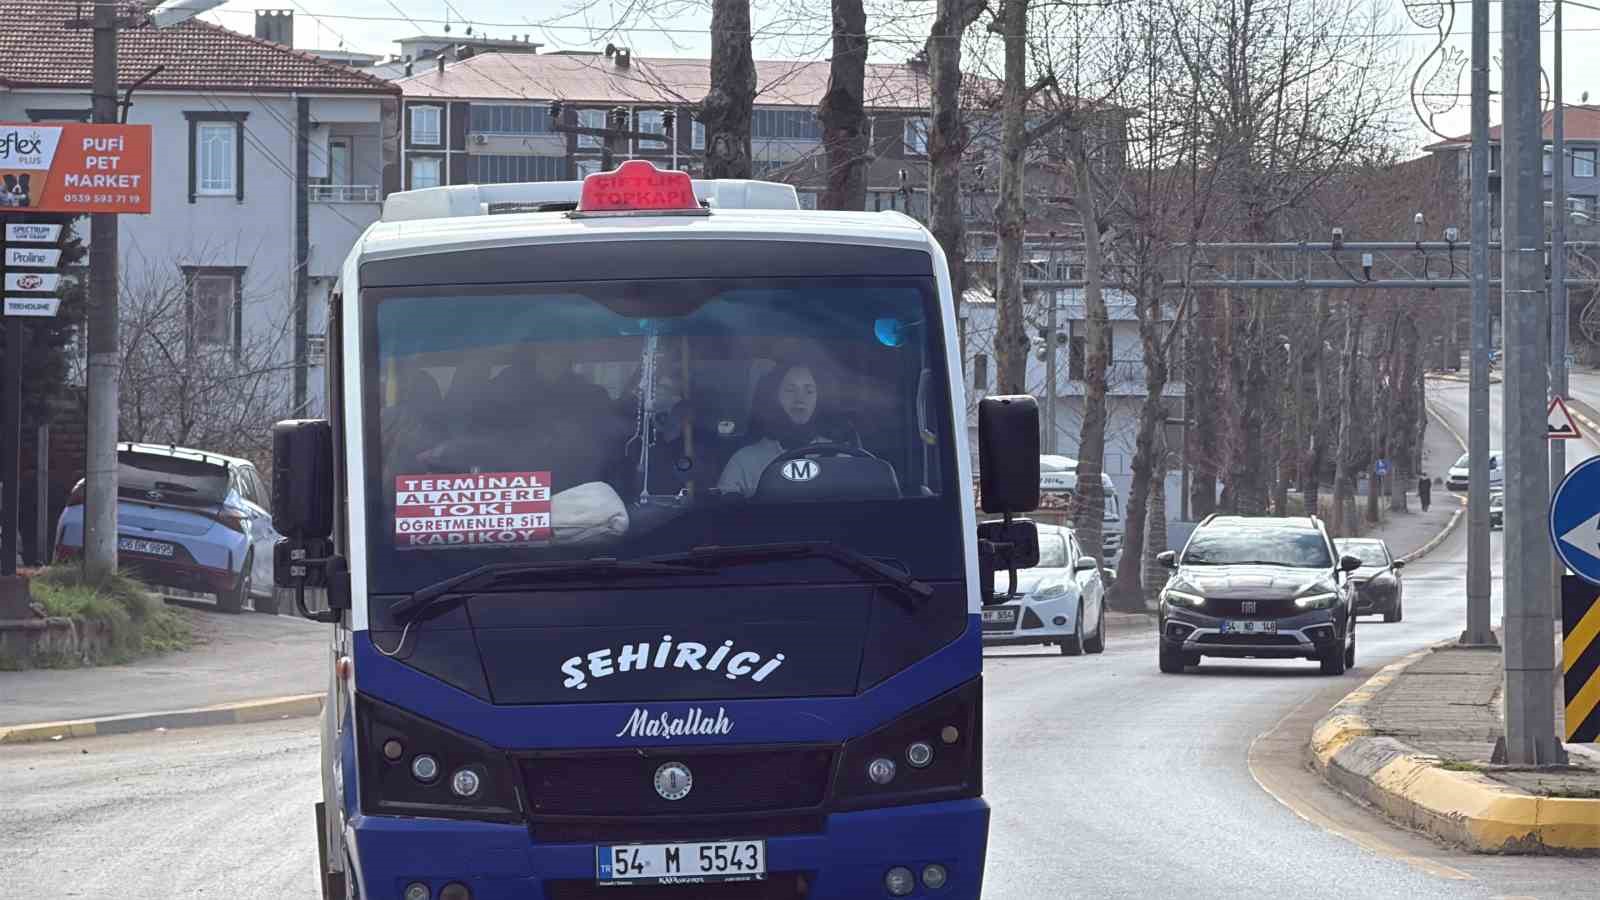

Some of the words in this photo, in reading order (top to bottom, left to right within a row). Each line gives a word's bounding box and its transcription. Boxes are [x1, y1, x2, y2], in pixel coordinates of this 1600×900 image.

[82, 136, 124, 151] PUFİ
[19, 156, 41, 165] PLUS
[86, 156, 121, 169] PET
[64, 174, 141, 188] MARKET
[594, 191, 689, 205] TOPKAPI
[13, 251, 46, 264] Proline
[791, 462, 811, 479] M
[404, 476, 542, 491] TERMİNAL
[402, 488, 545, 504] ALANDERE
[429, 502, 513, 516] TOKİ
[409, 528, 536, 545] KADIKÖY
[561, 635, 785, 690] ŞEHİRİÇİ
[616, 707, 734, 740] Maşallah
[615, 848, 644, 875] 54
[664, 847, 681, 873] M
[699, 844, 759, 872] 5543
[600, 864, 611, 873] TR
